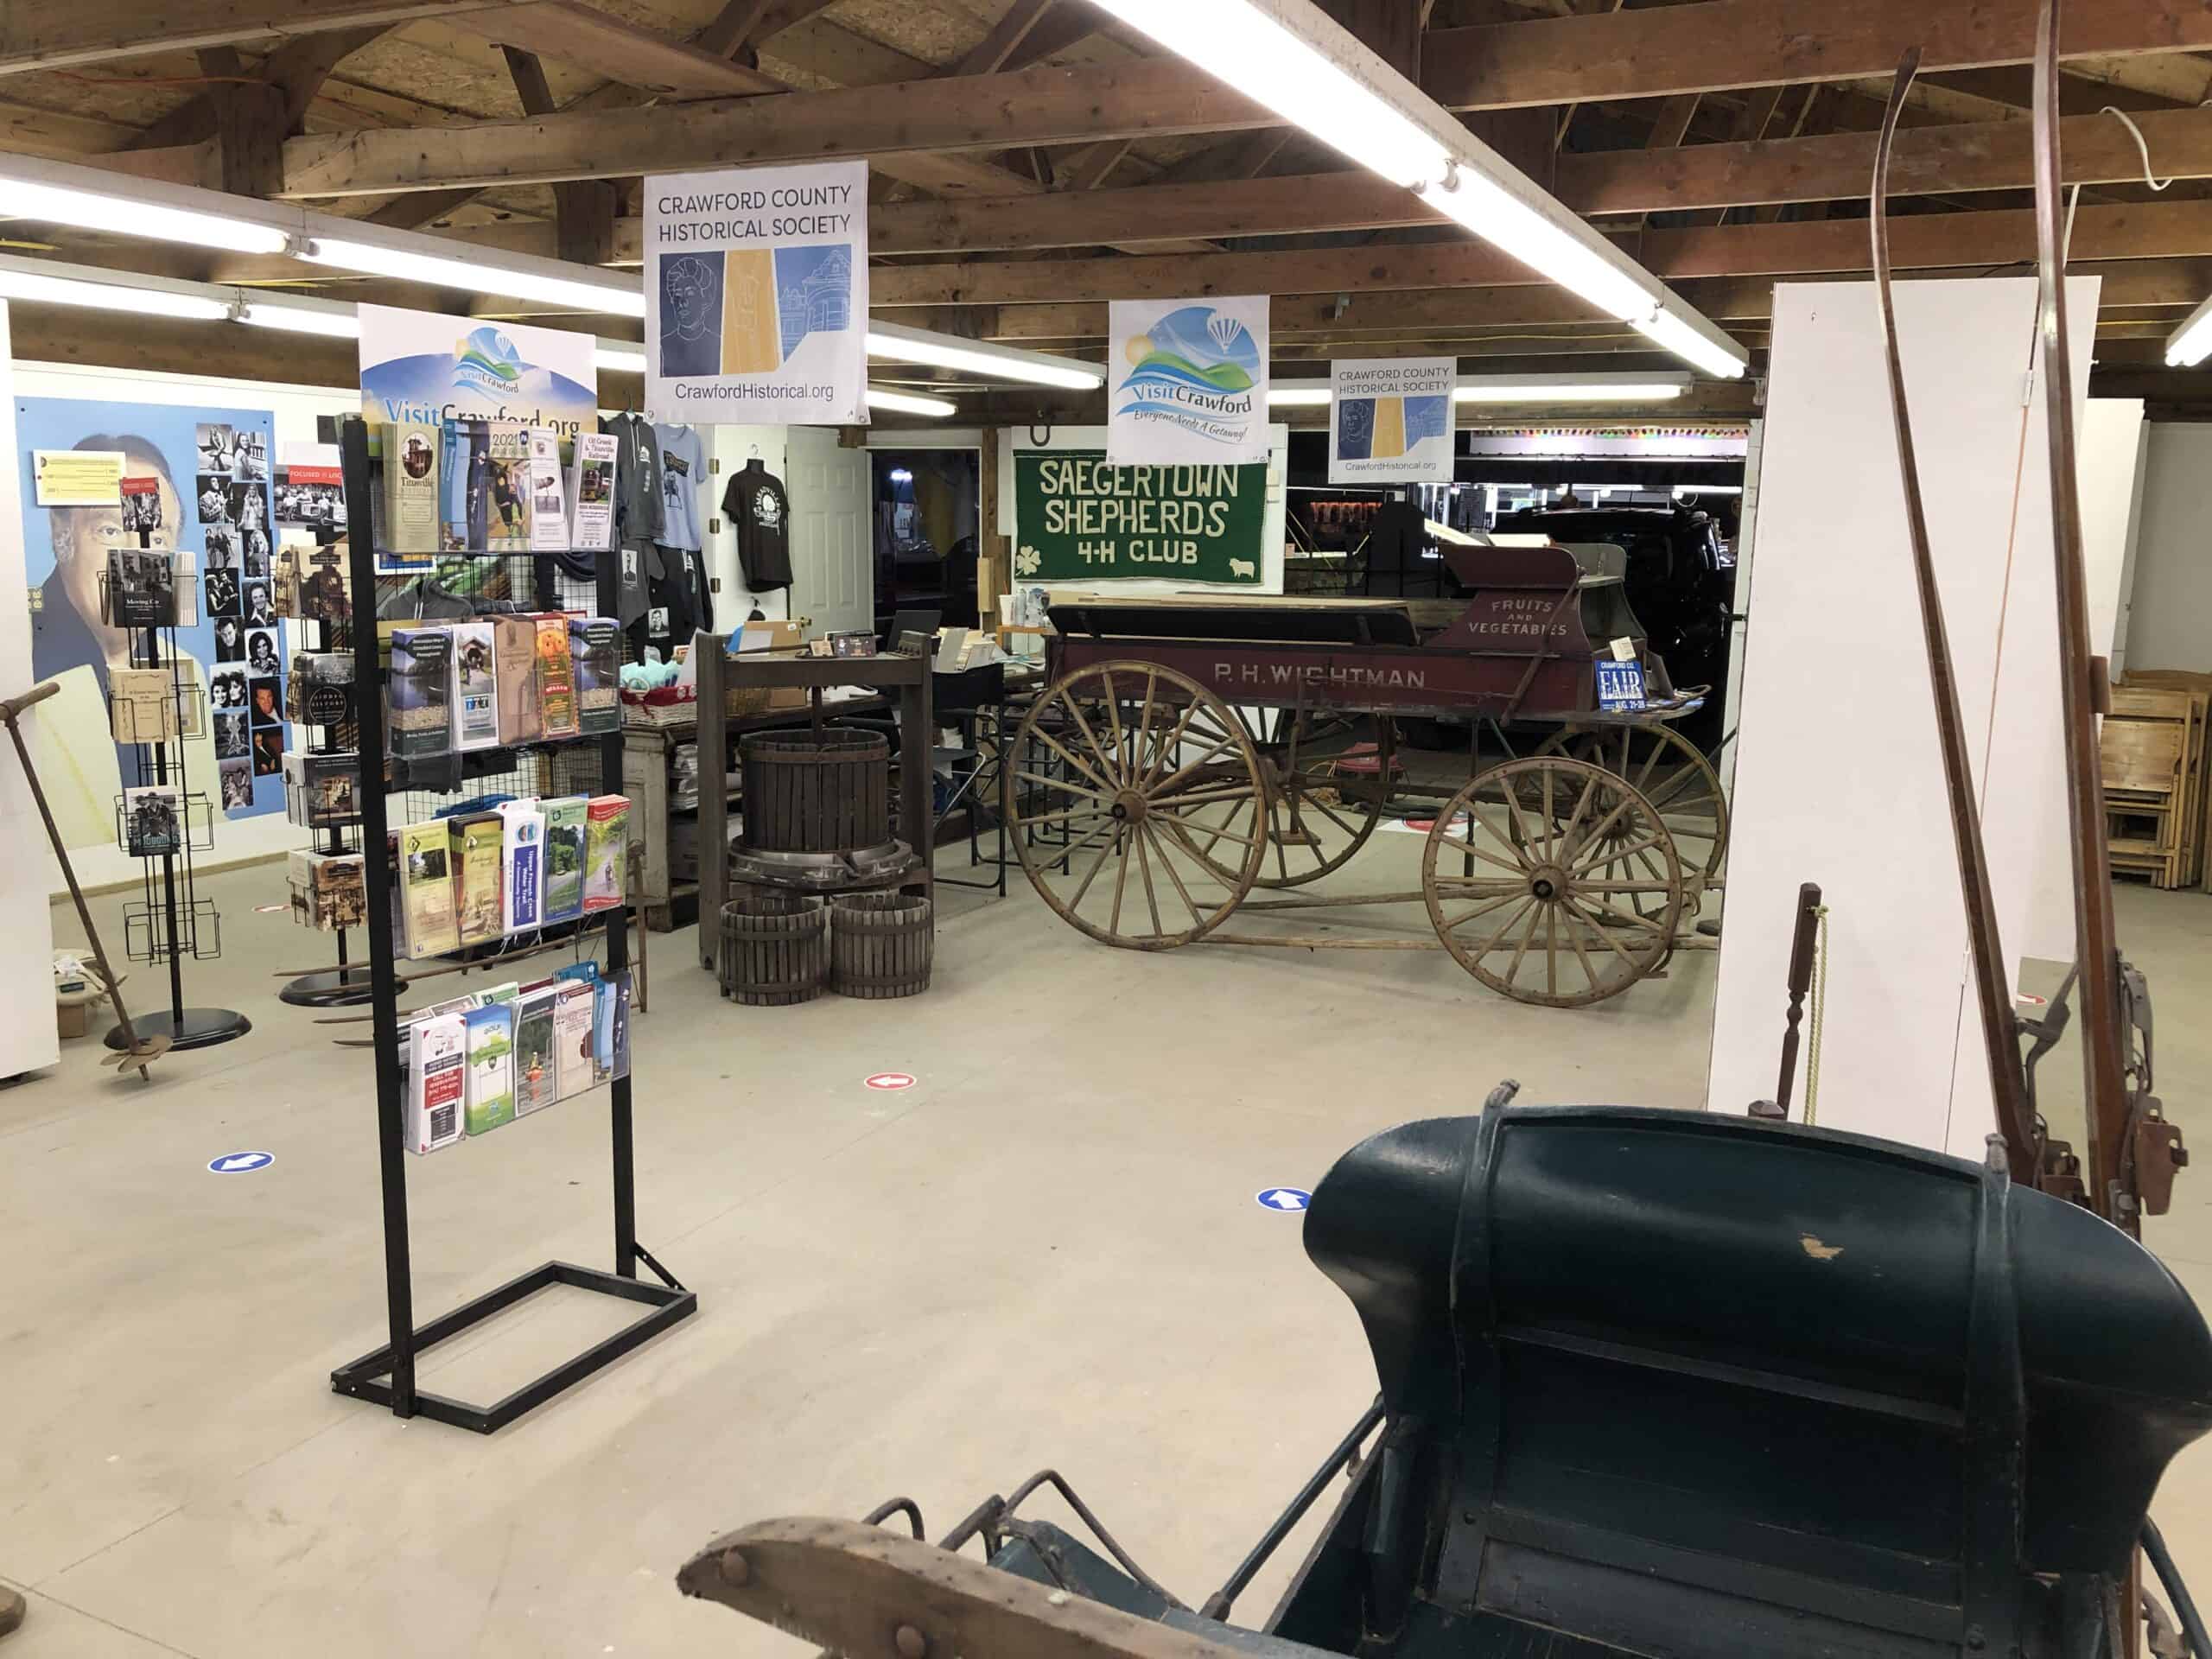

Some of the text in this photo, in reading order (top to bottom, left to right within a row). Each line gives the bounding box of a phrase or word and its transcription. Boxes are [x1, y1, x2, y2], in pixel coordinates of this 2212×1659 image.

[658, 185, 851, 214] CRAWFORD COUNTY
[659, 214, 851, 242] HISTORICAL SOCIETY
[1339, 367, 1449, 380] CRAWFORD COUNTY
[675, 383, 834, 401] CrawfordHistorical.org
[1133, 382, 1252, 413] VisitCrawford
[1339, 380, 1449, 394] HISTORICAL SOCIETY
[1135, 410, 1173, 422] Everyone
[1345, 461, 1436, 471] CrawfordHistorical.org
[1039, 460, 1239, 497] SAEGERTOWN
[1045, 499, 1230, 537] SHEPHERDS
[1077, 539, 1198, 563] 4-H CLUB
[1491, 600, 1554, 613] FRUITS
[1271, 664, 1425, 688] WIGHTMAN
[1599, 671, 1644, 700] FAIR
